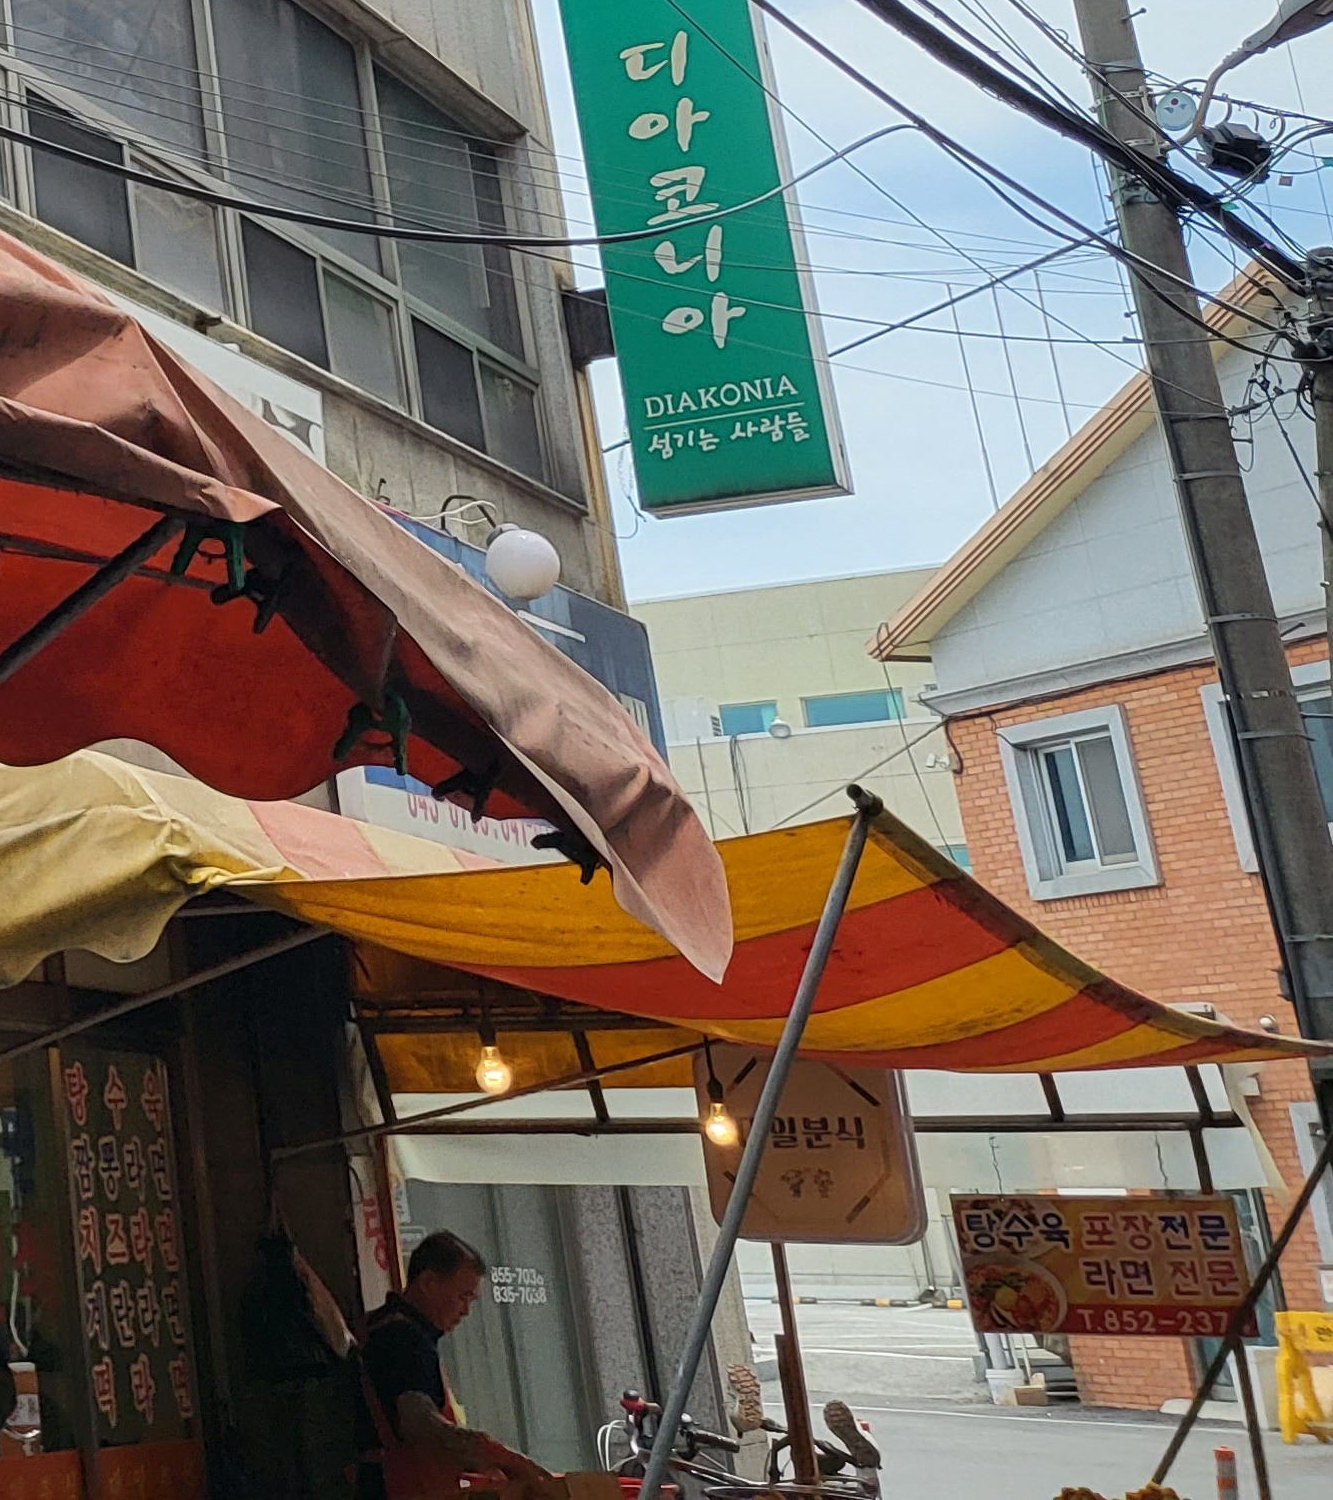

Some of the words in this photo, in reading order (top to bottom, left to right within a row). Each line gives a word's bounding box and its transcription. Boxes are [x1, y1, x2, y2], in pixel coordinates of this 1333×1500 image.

[619, 31, 746, 348] 디아코니아
[644, 375, 798, 418] DIAKONIA
[648, 429, 720, 460] 섬기는
[730, 411, 810, 442] 사람들
[965, 1212, 1070, 1249] 탕수육
[1083, 1258, 1154, 1296] 라면
[1167, 1260, 1240, 1297] 전문
[1076, 1309, 1250, 1334] T.852-237
